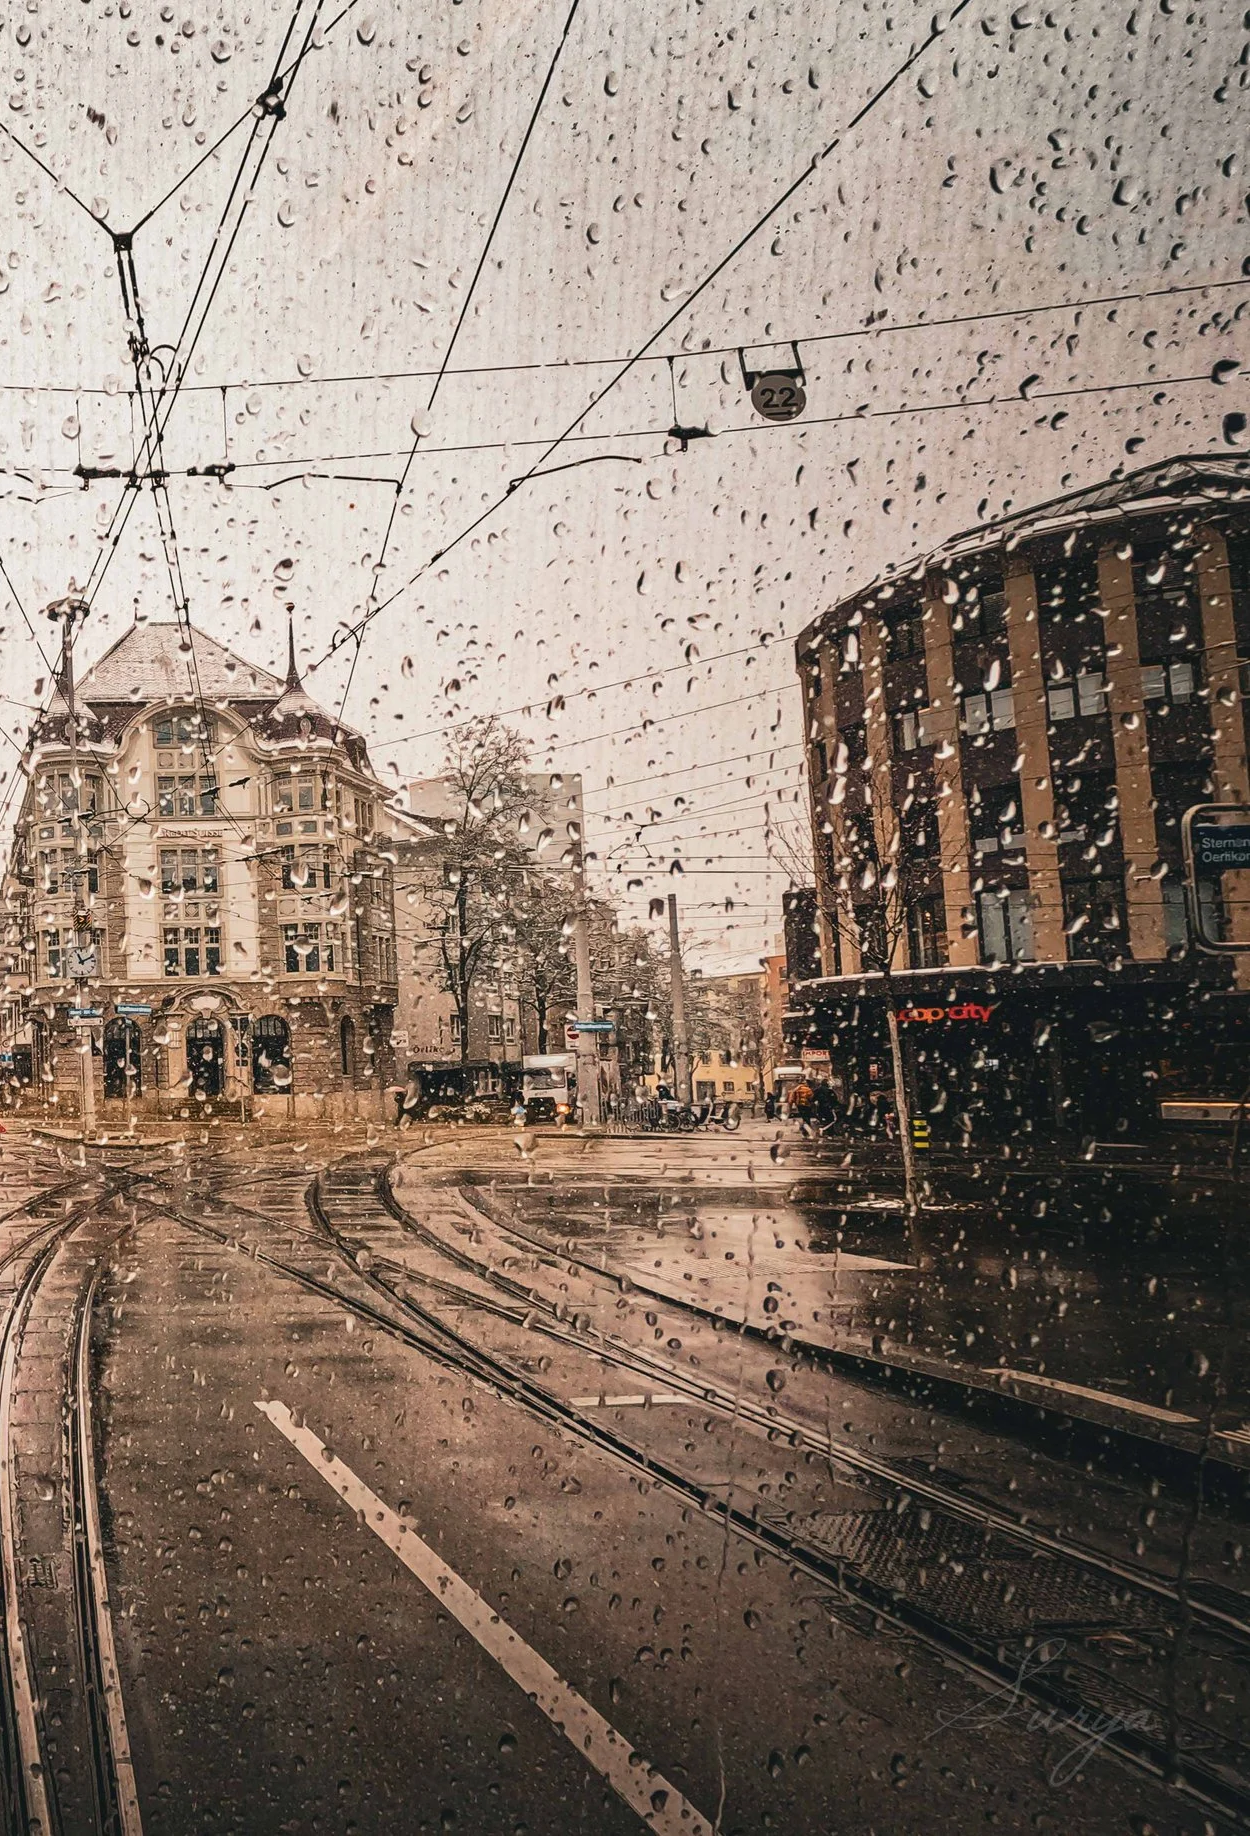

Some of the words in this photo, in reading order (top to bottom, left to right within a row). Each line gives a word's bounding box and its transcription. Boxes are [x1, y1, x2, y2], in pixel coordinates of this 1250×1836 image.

[760, 387, 798, 408] 22
[896, 1007, 945, 1024] oop
[948, 1003, 994, 1023] city
